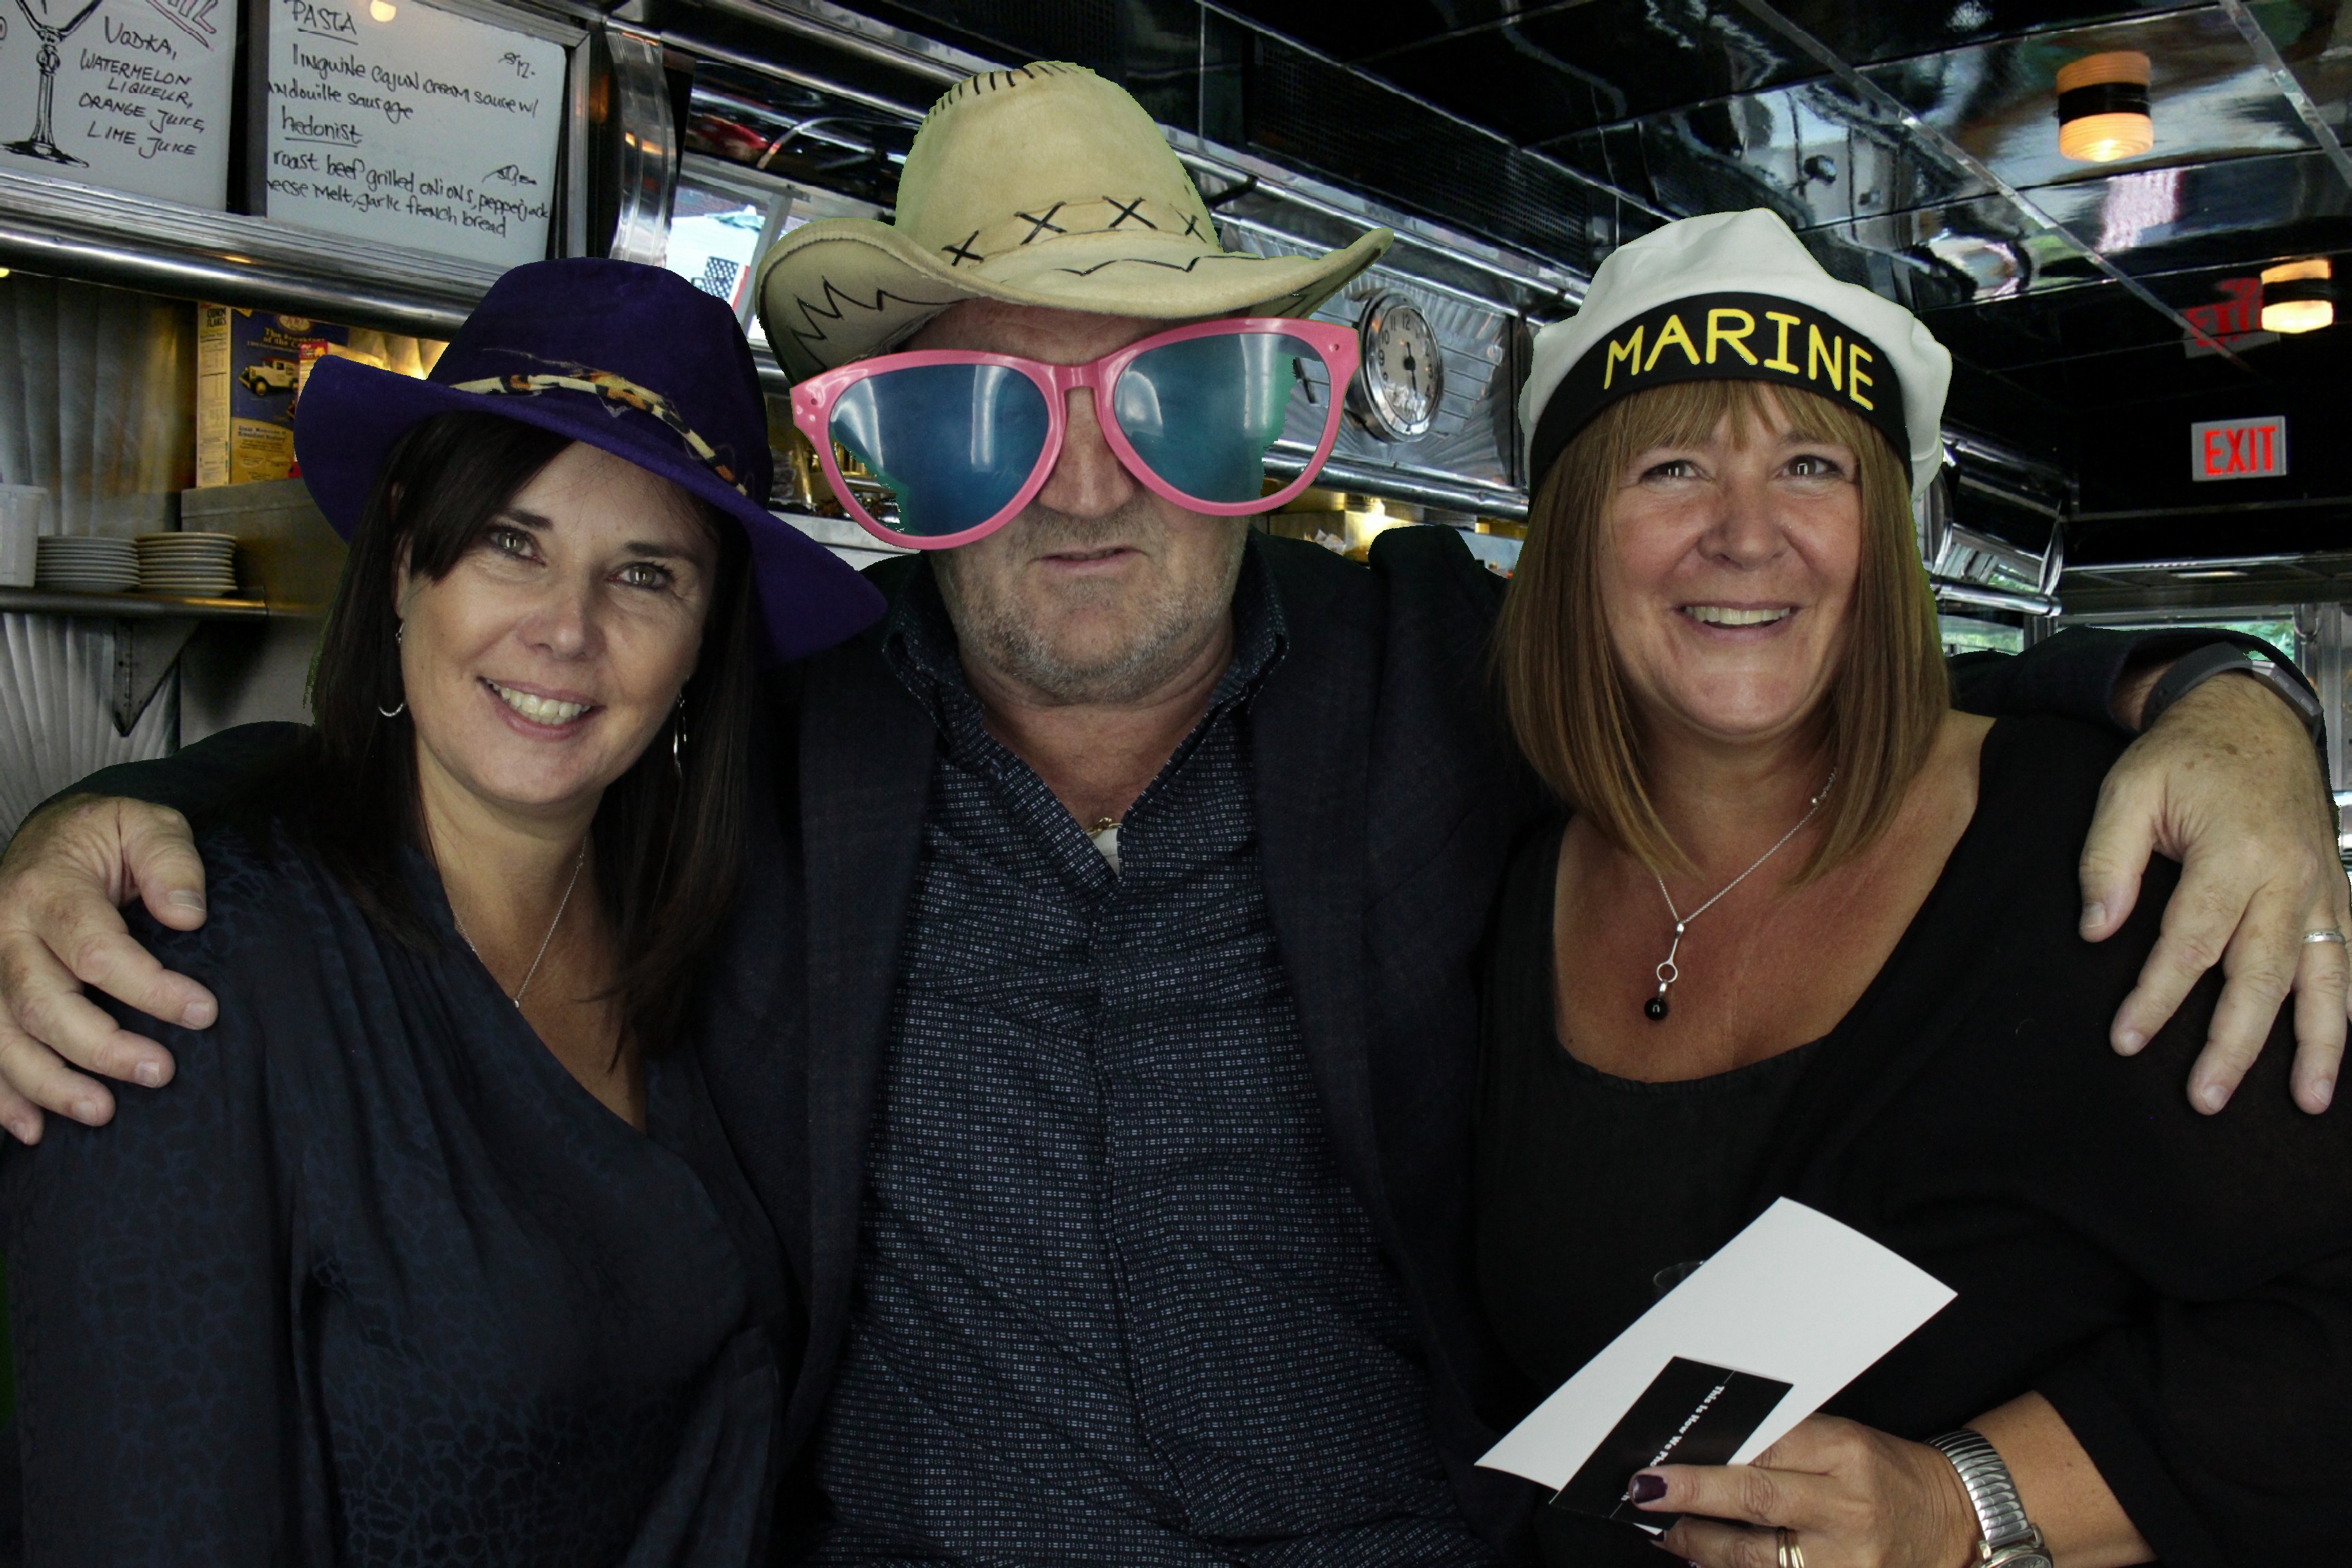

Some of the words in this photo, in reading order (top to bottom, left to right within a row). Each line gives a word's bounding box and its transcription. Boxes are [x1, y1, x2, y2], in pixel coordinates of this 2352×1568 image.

[284, 0, 357, 35] PASTA
[105, 16, 177, 60] VODKA,
[80, 48, 192, 86] WATERMELON
[79, 93, 146, 118] ORANGE
[108, 78, 193, 108] LIQUEUR,
[88, 121, 136, 145] LIME
[139, 137, 197, 159] JUICE
[282, 105, 363, 144] hedonist
[274, 150, 319, 171] roast
[327, 154, 365, 180] beef
[366, 169, 414, 192] grilled
[357, 193, 401, 212] garlic
[462, 210, 506, 238] bread
[1603, 308, 1874, 411] MARINE
[2204, 425, 2277, 476] EXIT
[1695, 1405, 1708, 1414] Is
[1703, 1385, 1725, 1403] This
[1678, 1414, 1699, 1434] How
[1650, 1450, 1668, 1467] Pho
[1664, 1435, 1682, 1450] We
